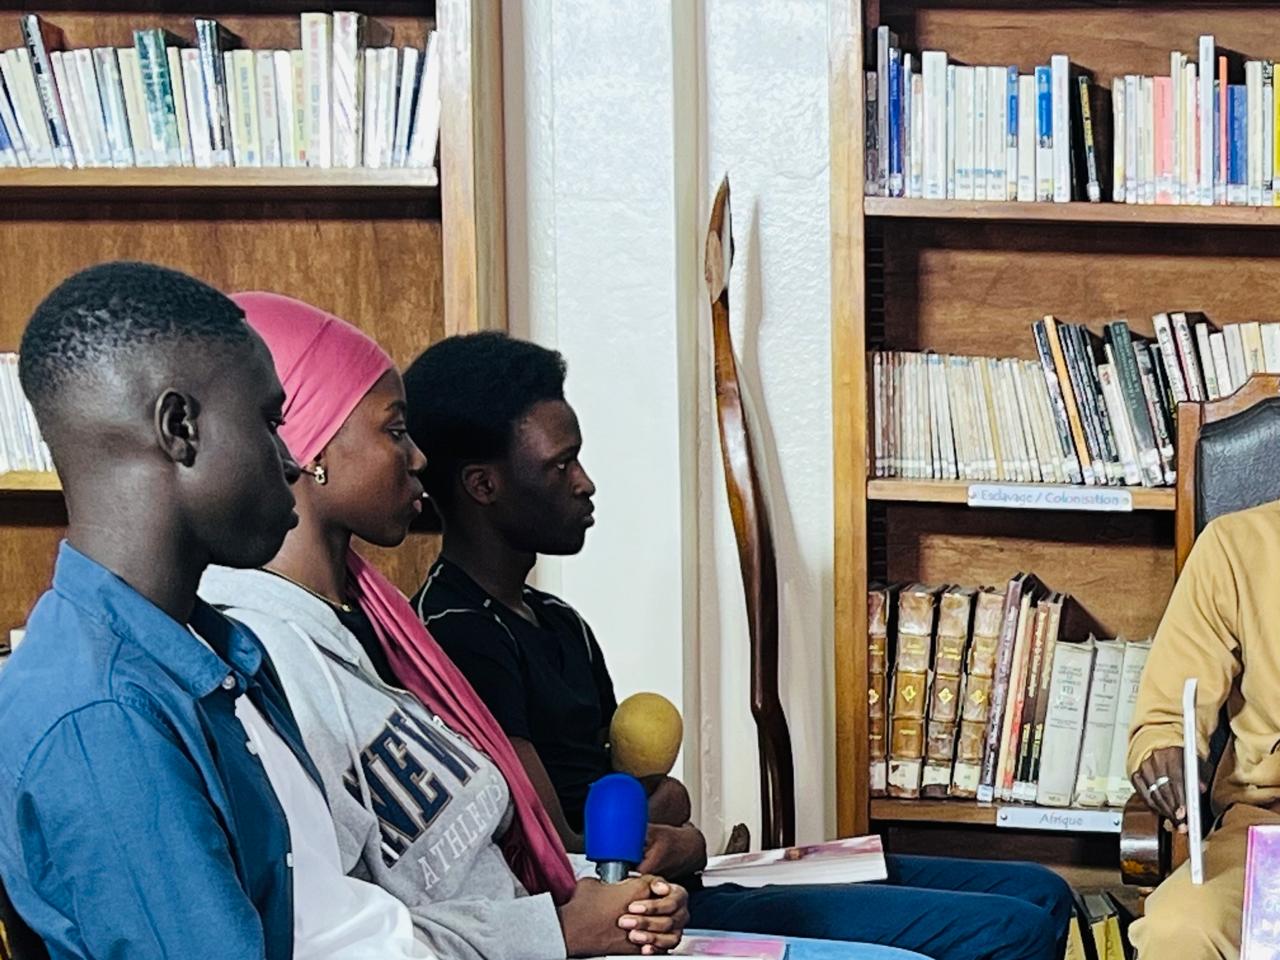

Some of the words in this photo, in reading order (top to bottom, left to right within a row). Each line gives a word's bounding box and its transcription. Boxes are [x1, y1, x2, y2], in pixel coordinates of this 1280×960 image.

[981, 490, 1033, 505] Esclavage
[1044, 491, 1120, 506] Colonisation
[1039, 813, 1084, 829] Afrique
